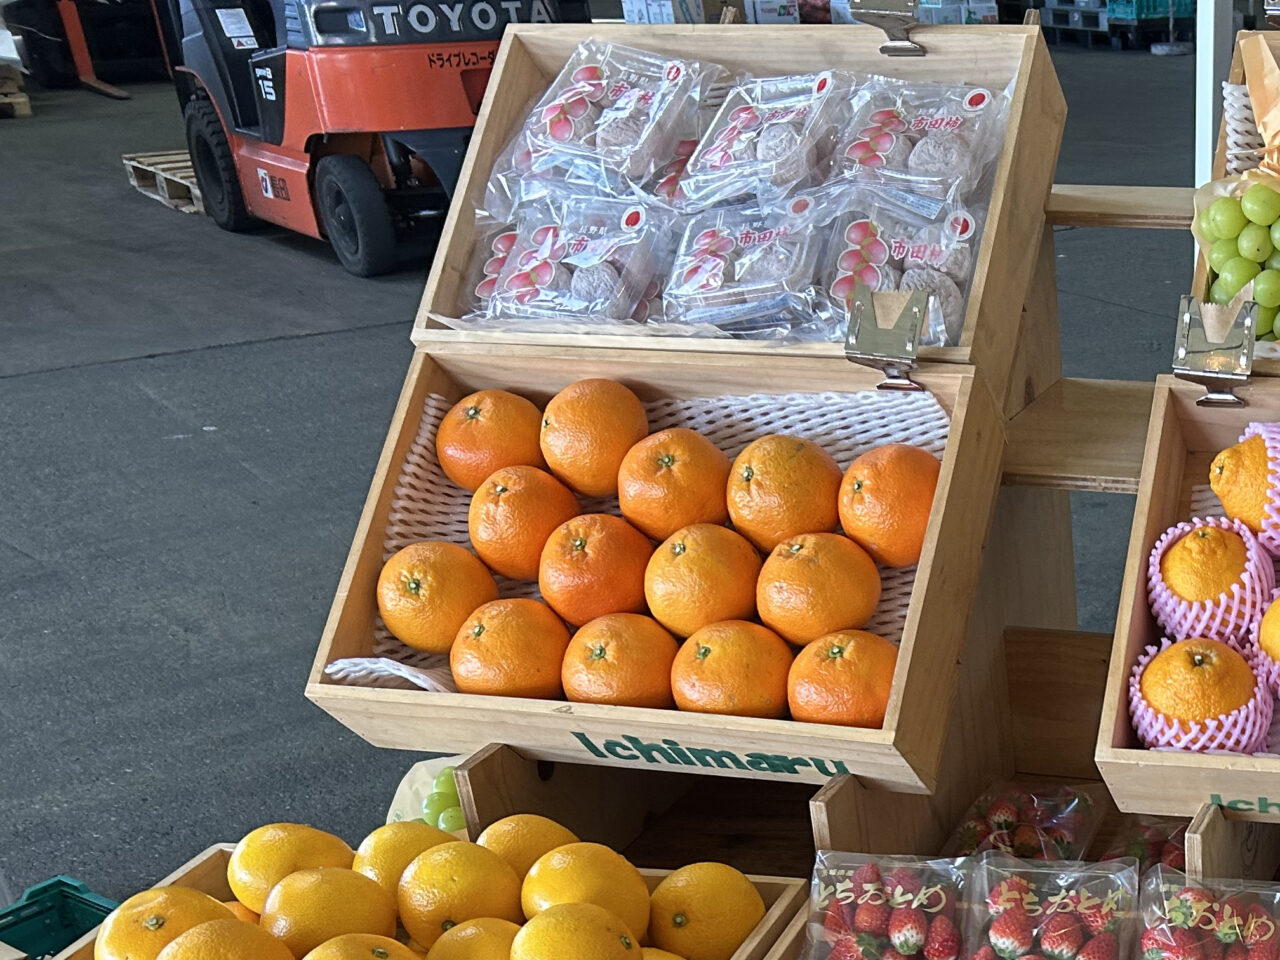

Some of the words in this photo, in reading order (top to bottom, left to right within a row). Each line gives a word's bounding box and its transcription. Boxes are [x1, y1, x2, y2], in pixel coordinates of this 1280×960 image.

[373, 0, 552, 36] TOYOTA
[259, 80, 276, 100] 15
[910, 115, 963, 132] 市田柿
[570, 731, 850, 777] Ichimaru
[816, 878, 947, 914] とちおとめ
